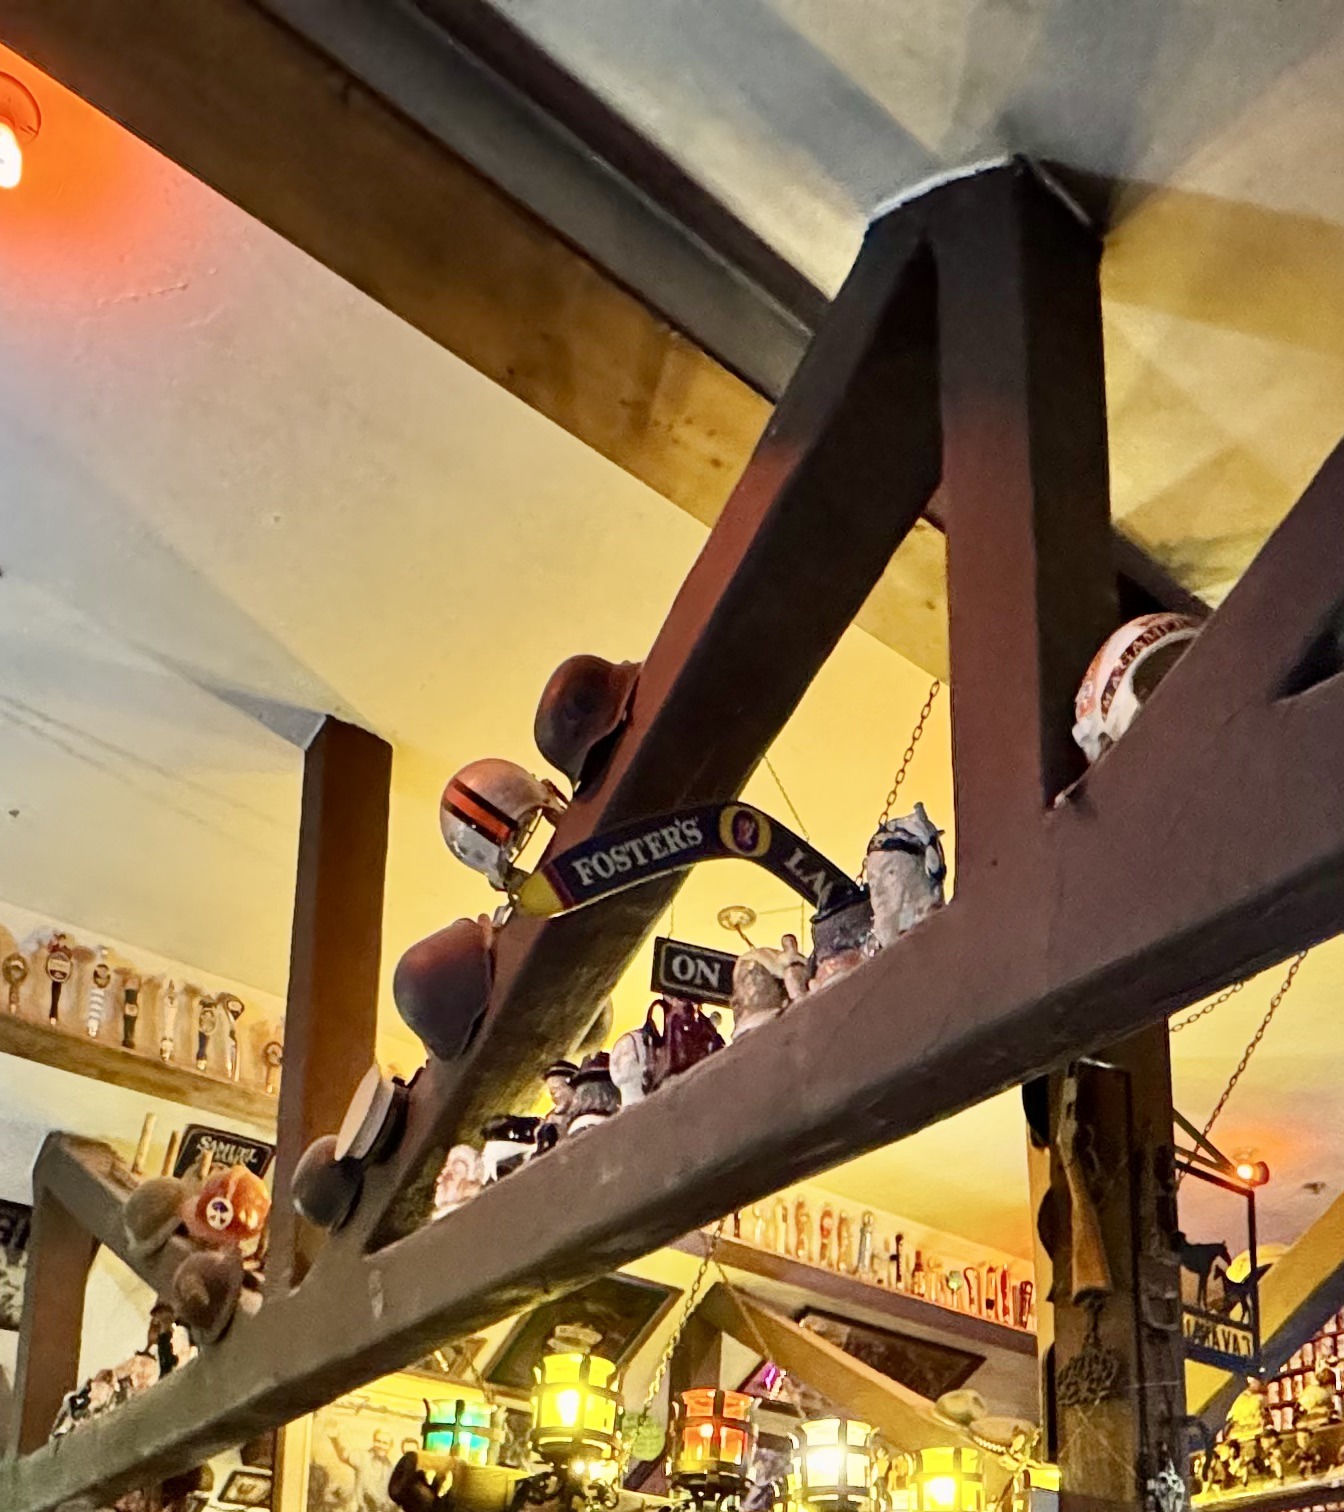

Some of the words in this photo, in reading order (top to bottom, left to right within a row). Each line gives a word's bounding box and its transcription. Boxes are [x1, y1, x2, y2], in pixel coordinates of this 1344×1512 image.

[572, 815, 704, 887] FOSTER'S
[784, 847, 834, 917] LA
[671, 954, 722, 988] ON
